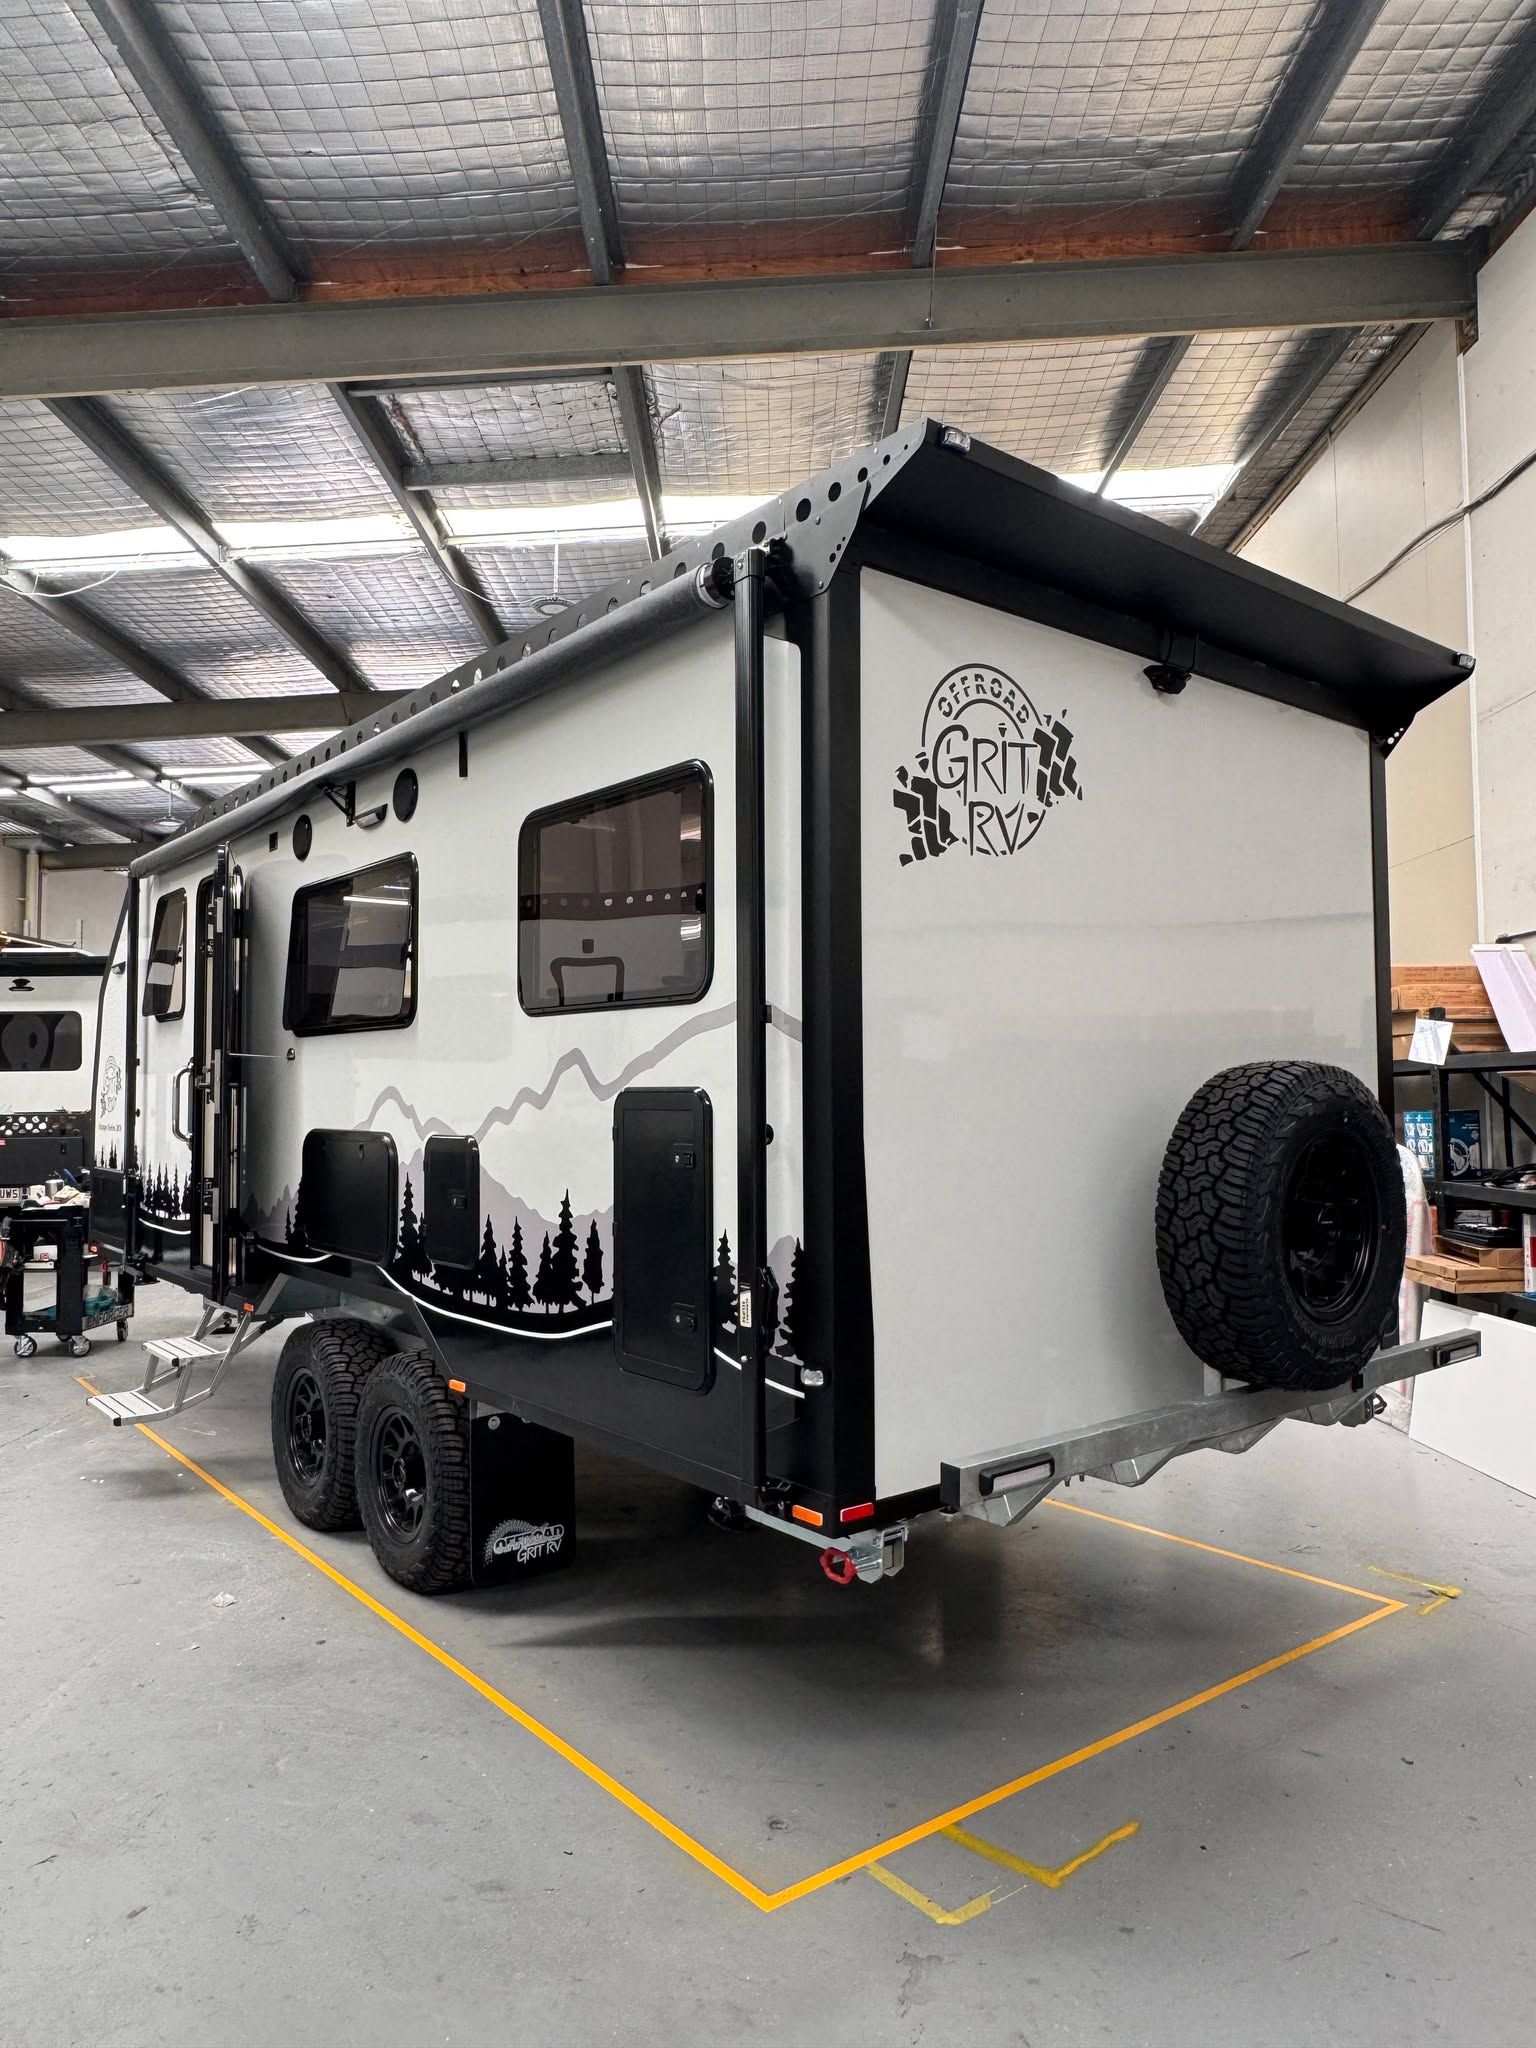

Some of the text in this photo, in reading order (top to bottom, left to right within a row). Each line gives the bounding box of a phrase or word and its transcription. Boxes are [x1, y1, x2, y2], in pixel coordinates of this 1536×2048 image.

[938, 673, 1029, 723] OFFROAD
[932, 724, 1038, 806] GRIT
[969, 800, 1024, 857] RV
[494, 1524, 564, 1554] OFFROAD
[517, 1539, 562, 1564] GRIT RV
